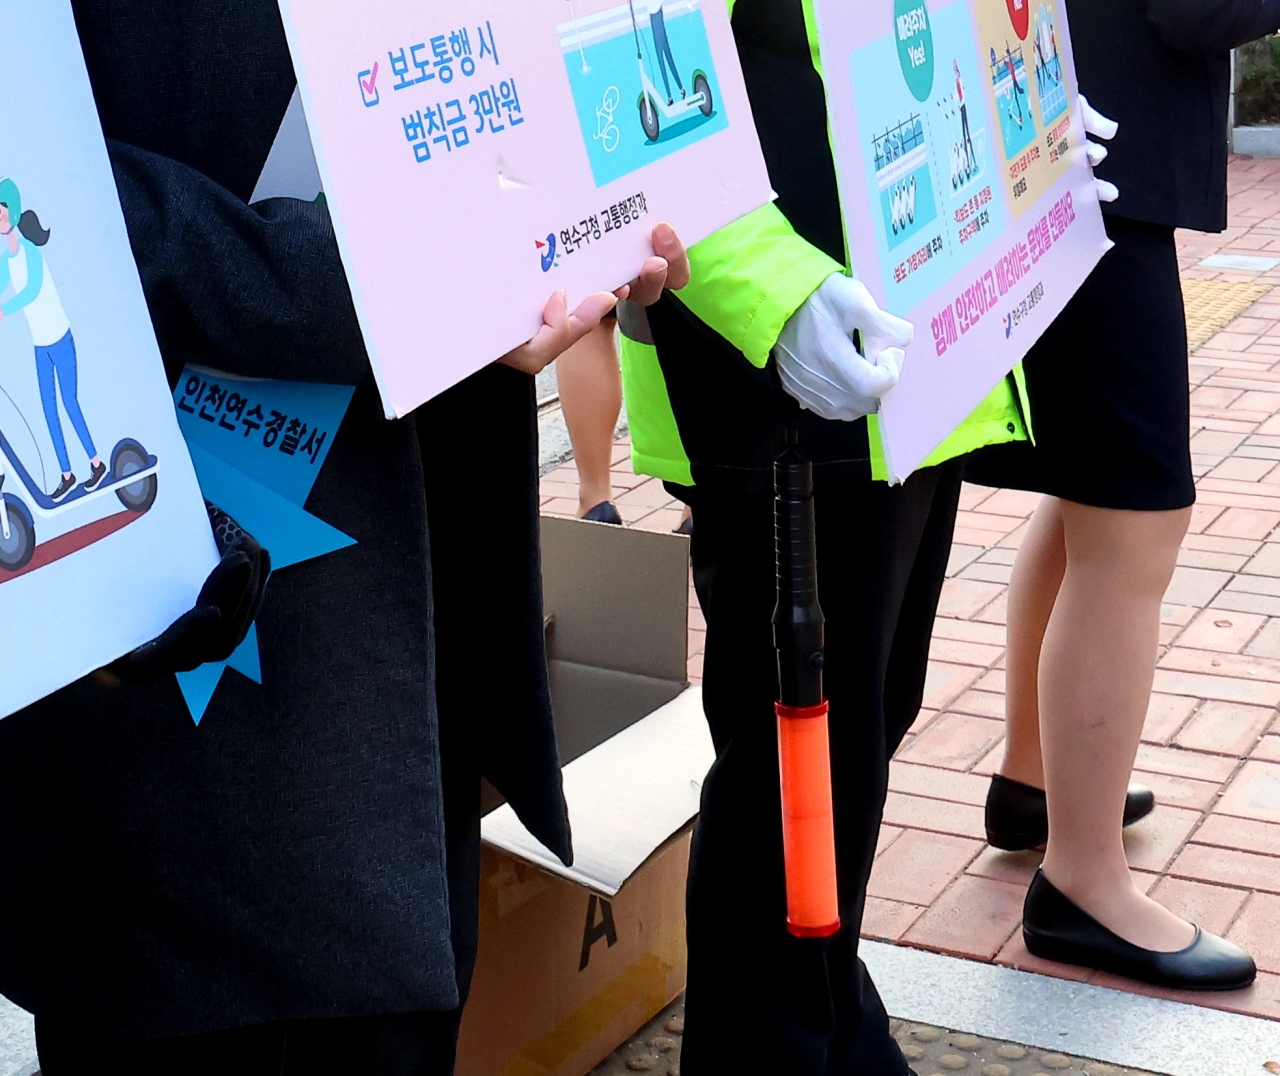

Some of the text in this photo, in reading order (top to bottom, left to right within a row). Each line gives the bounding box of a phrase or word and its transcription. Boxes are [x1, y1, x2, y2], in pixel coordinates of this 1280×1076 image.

[388, 20, 500, 91] 보도통행 시
[897, 5, 927, 41] 배려주차
[907, 39, 925, 69] Yes!
[401, 77, 525, 164] 범칙금 3만원
[559, 191, 649, 255] 연수구청 교통행정과
[931, 234, 943, 256] 주차
[931, 190, 1076, 357] 함께 안전하고 배려하는 문화를 만들어요
[178, 375, 328, 464] 인천연수경찰서
